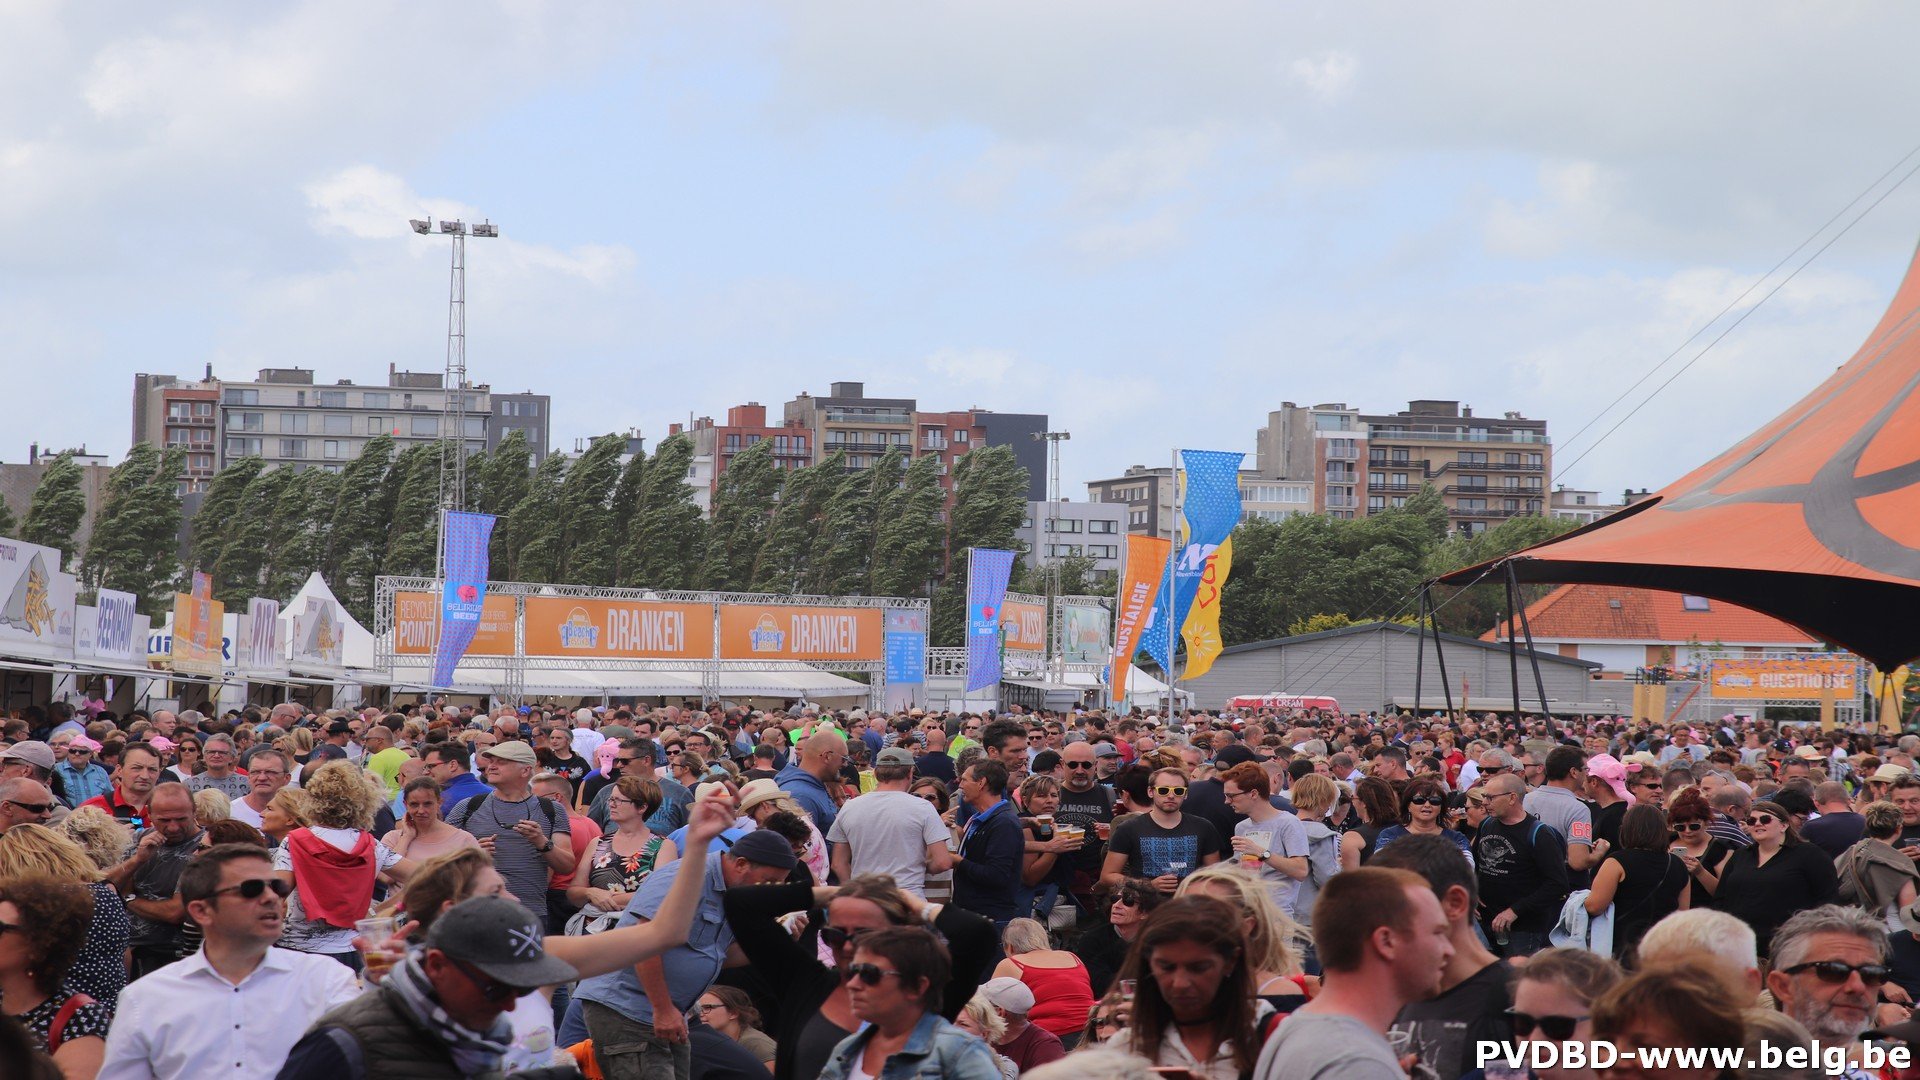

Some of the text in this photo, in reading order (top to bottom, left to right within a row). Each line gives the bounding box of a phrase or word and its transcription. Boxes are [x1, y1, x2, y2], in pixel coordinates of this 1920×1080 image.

[401, 600, 434, 619] RECYCLE
[453, 612, 478, 620] BEERS
[400, 620, 433, 647] POINT
[607, 608, 684, 652] DRANKEN
[791, 614, 857, 653] DRANKEN
[1759, 673, 1849, 689] GUESTHOUSE
[1276, 699, 1304, 708] CREAM
